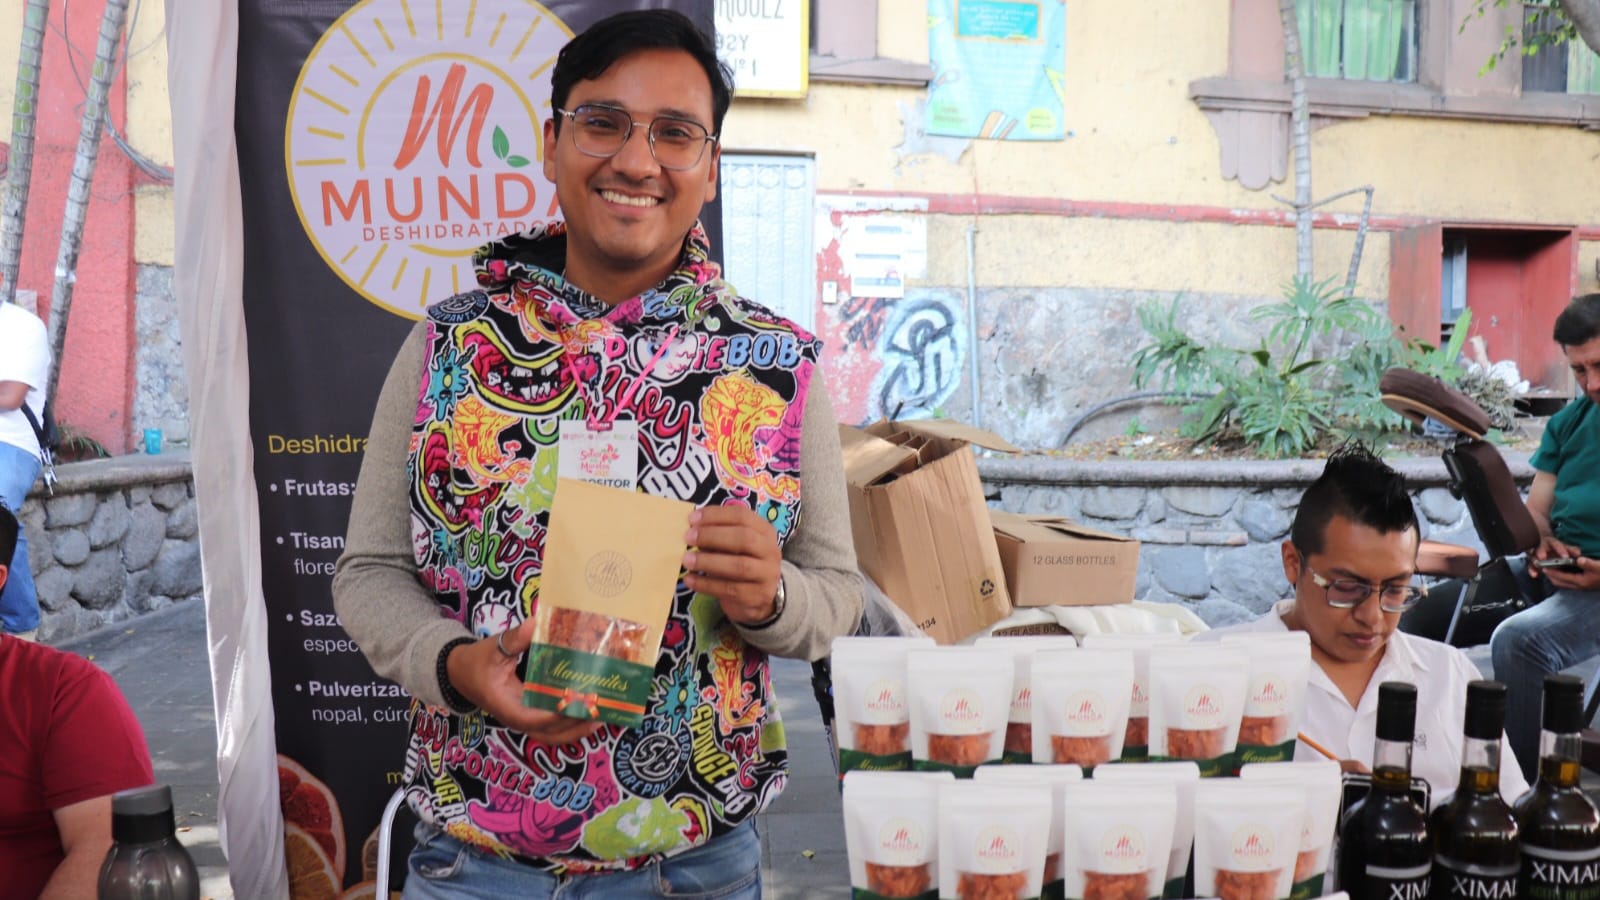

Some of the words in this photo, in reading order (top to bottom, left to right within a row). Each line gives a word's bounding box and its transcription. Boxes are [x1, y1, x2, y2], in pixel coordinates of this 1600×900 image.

[320, 172, 563, 227] MUND
[362, 219, 556, 243] DESHIDRATAD
[284, 479, 357, 497] Frutas:
[289, 532, 345, 549] Tisan
[293, 558, 336, 575] flore
[1032, 555, 1043, 565] 12
[1044, 555, 1074, 565] GLASS
[1076, 555, 1116, 565] BOTTLES
[303, 637, 359, 654] espec
[548, 657, 630, 693] Manguitos
[311, 706, 368, 724] nopal,
[1389, 878, 1430, 900] XIM
